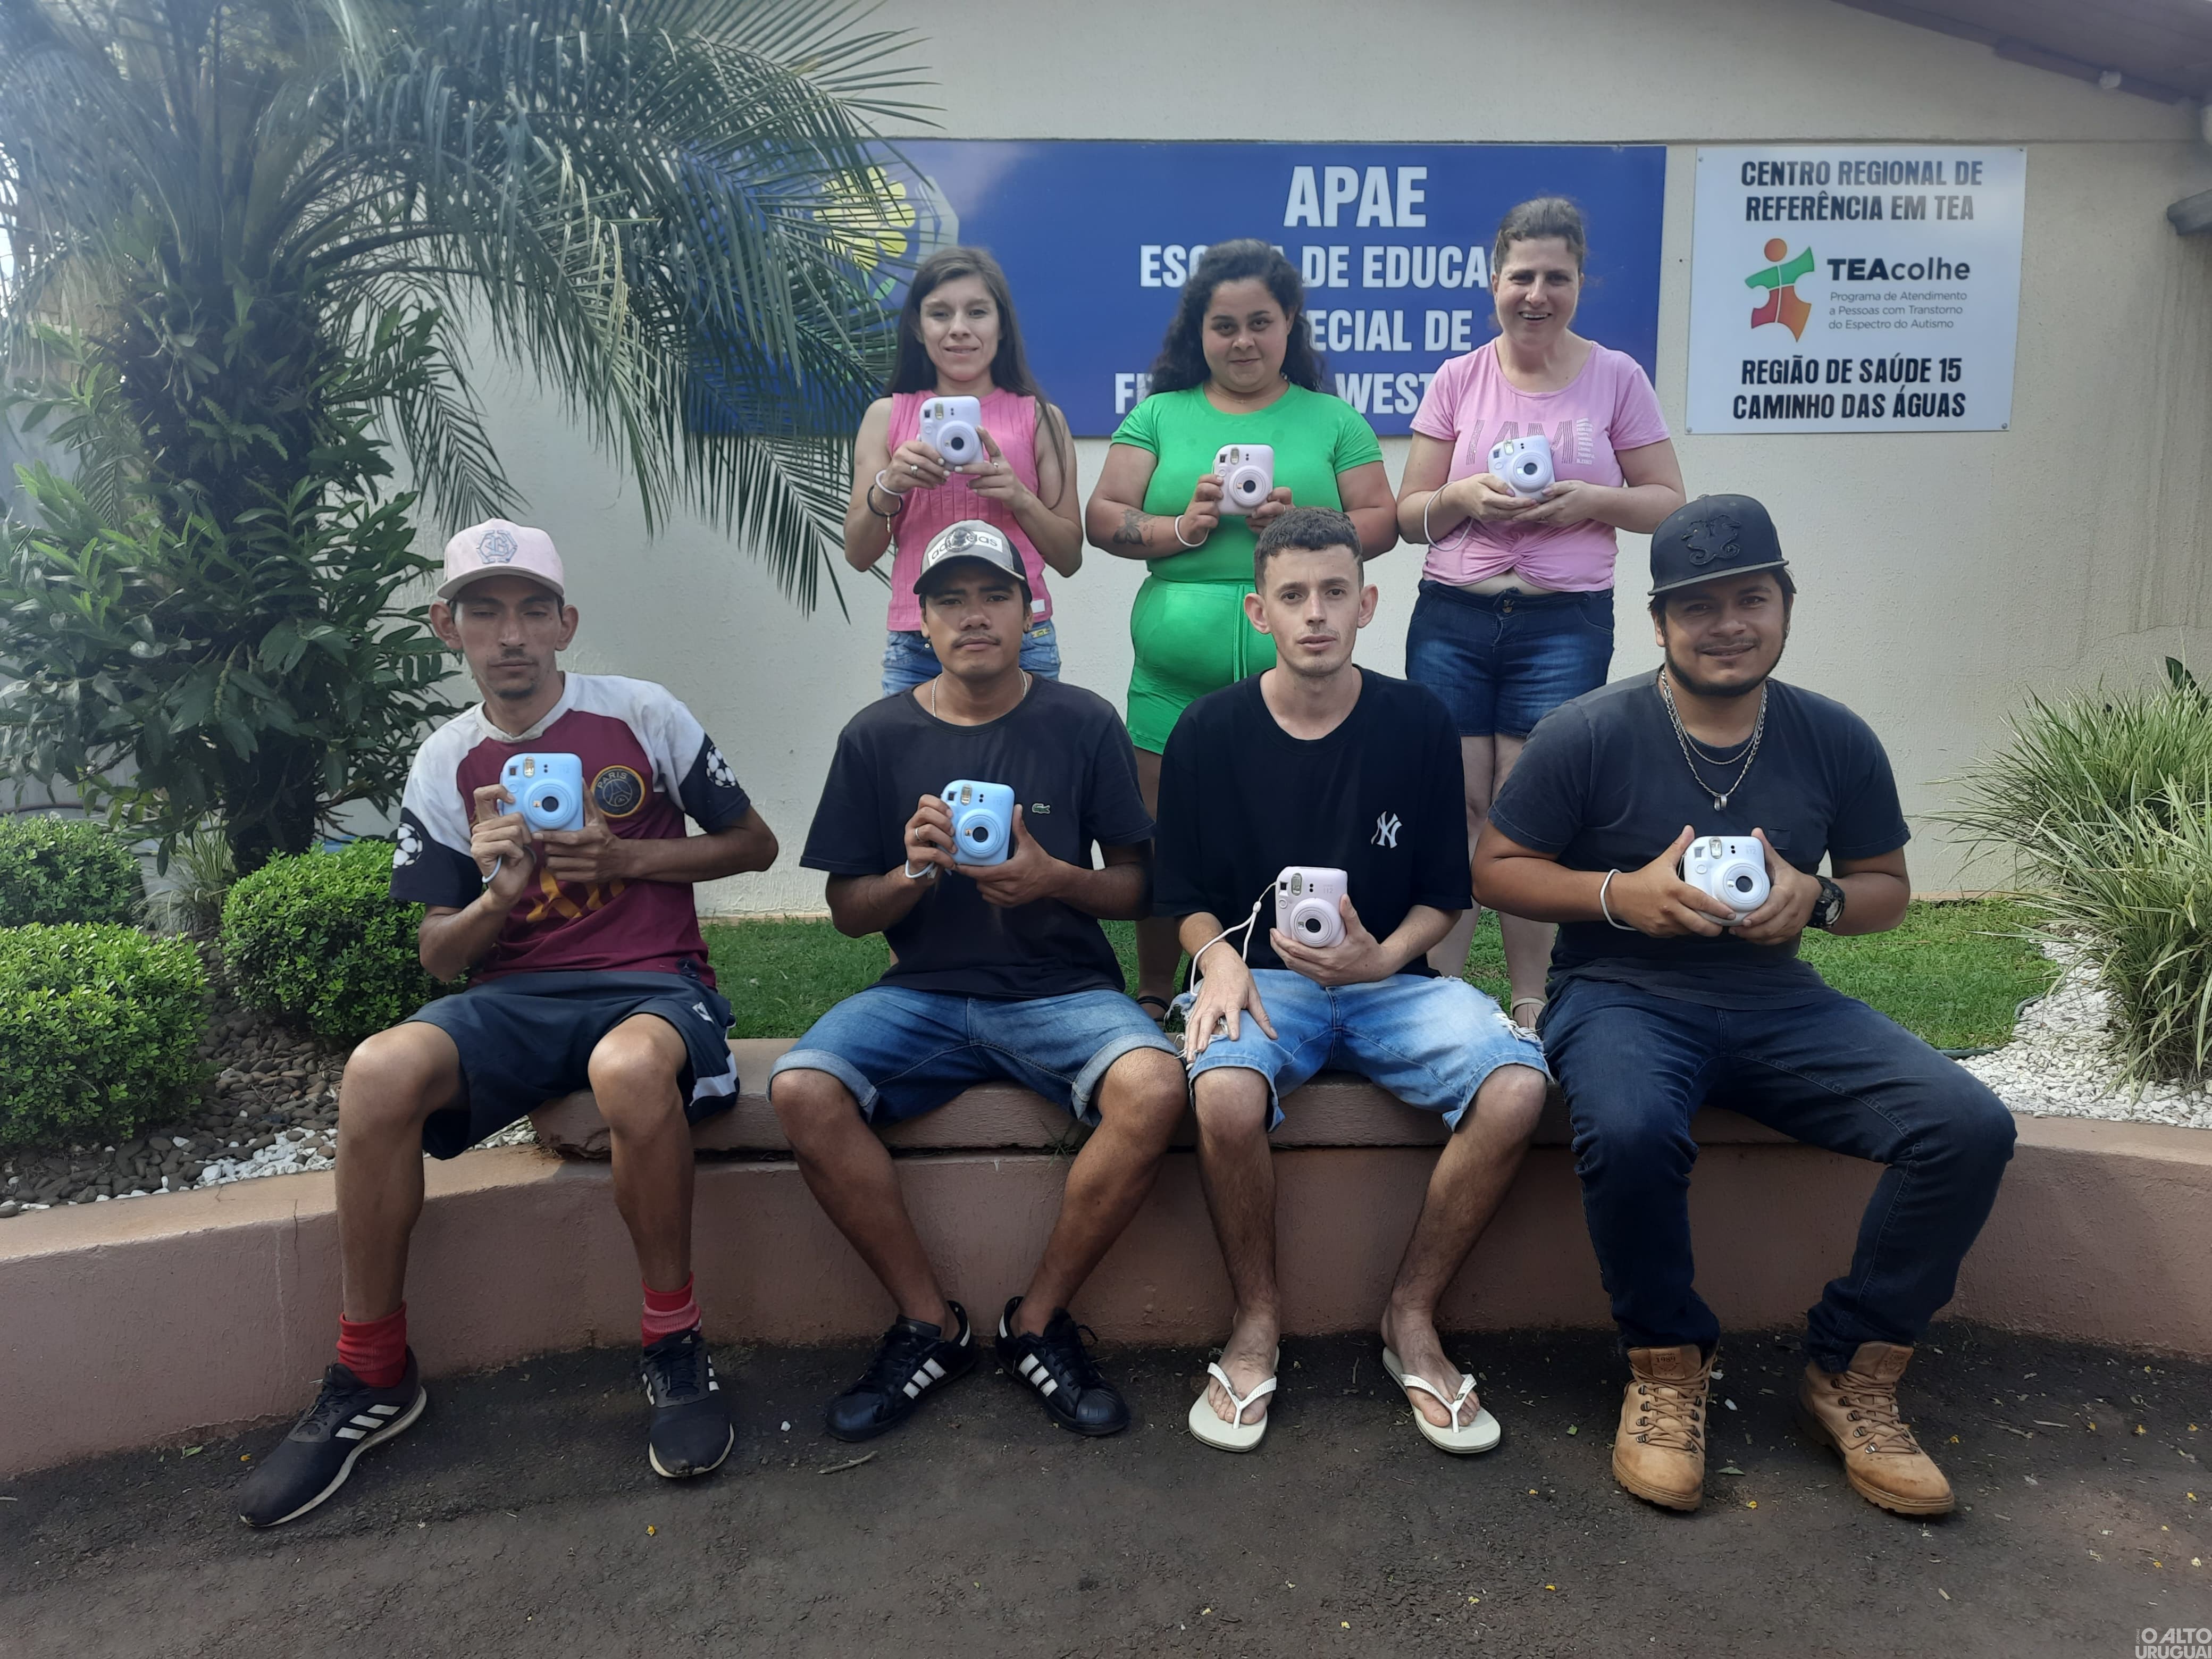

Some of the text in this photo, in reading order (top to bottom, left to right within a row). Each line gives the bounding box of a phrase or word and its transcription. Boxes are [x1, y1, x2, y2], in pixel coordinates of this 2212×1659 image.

[1741, 161, 1983, 186] CENTRO REGIONAL DE
[1283, 166, 1427, 227] APAE
[1746, 190, 1974, 221] REFERÊNCIA EM TEA
[1302, 245, 1352, 288] DE
[1362, 246, 1495, 288] EDUCA
[1827, 257, 1970, 280] TEAcolhe
[1830, 291, 1967, 302] Programa de Atendimento
[1839, 306, 1879, 315] Pessoas
[1908, 305, 1963, 314] Transtorno
[1306, 309, 1472, 351] ECIAL DE
[1829, 319, 1954, 330] do Espectro do Autismo
[1741, 353, 1962, 384] REGIÃO DE SAÚDE 15
[1733, 385, 1966, 420] CAMINHO DAS ÁGUAS
[597, 771, 628, 789] PARIS
